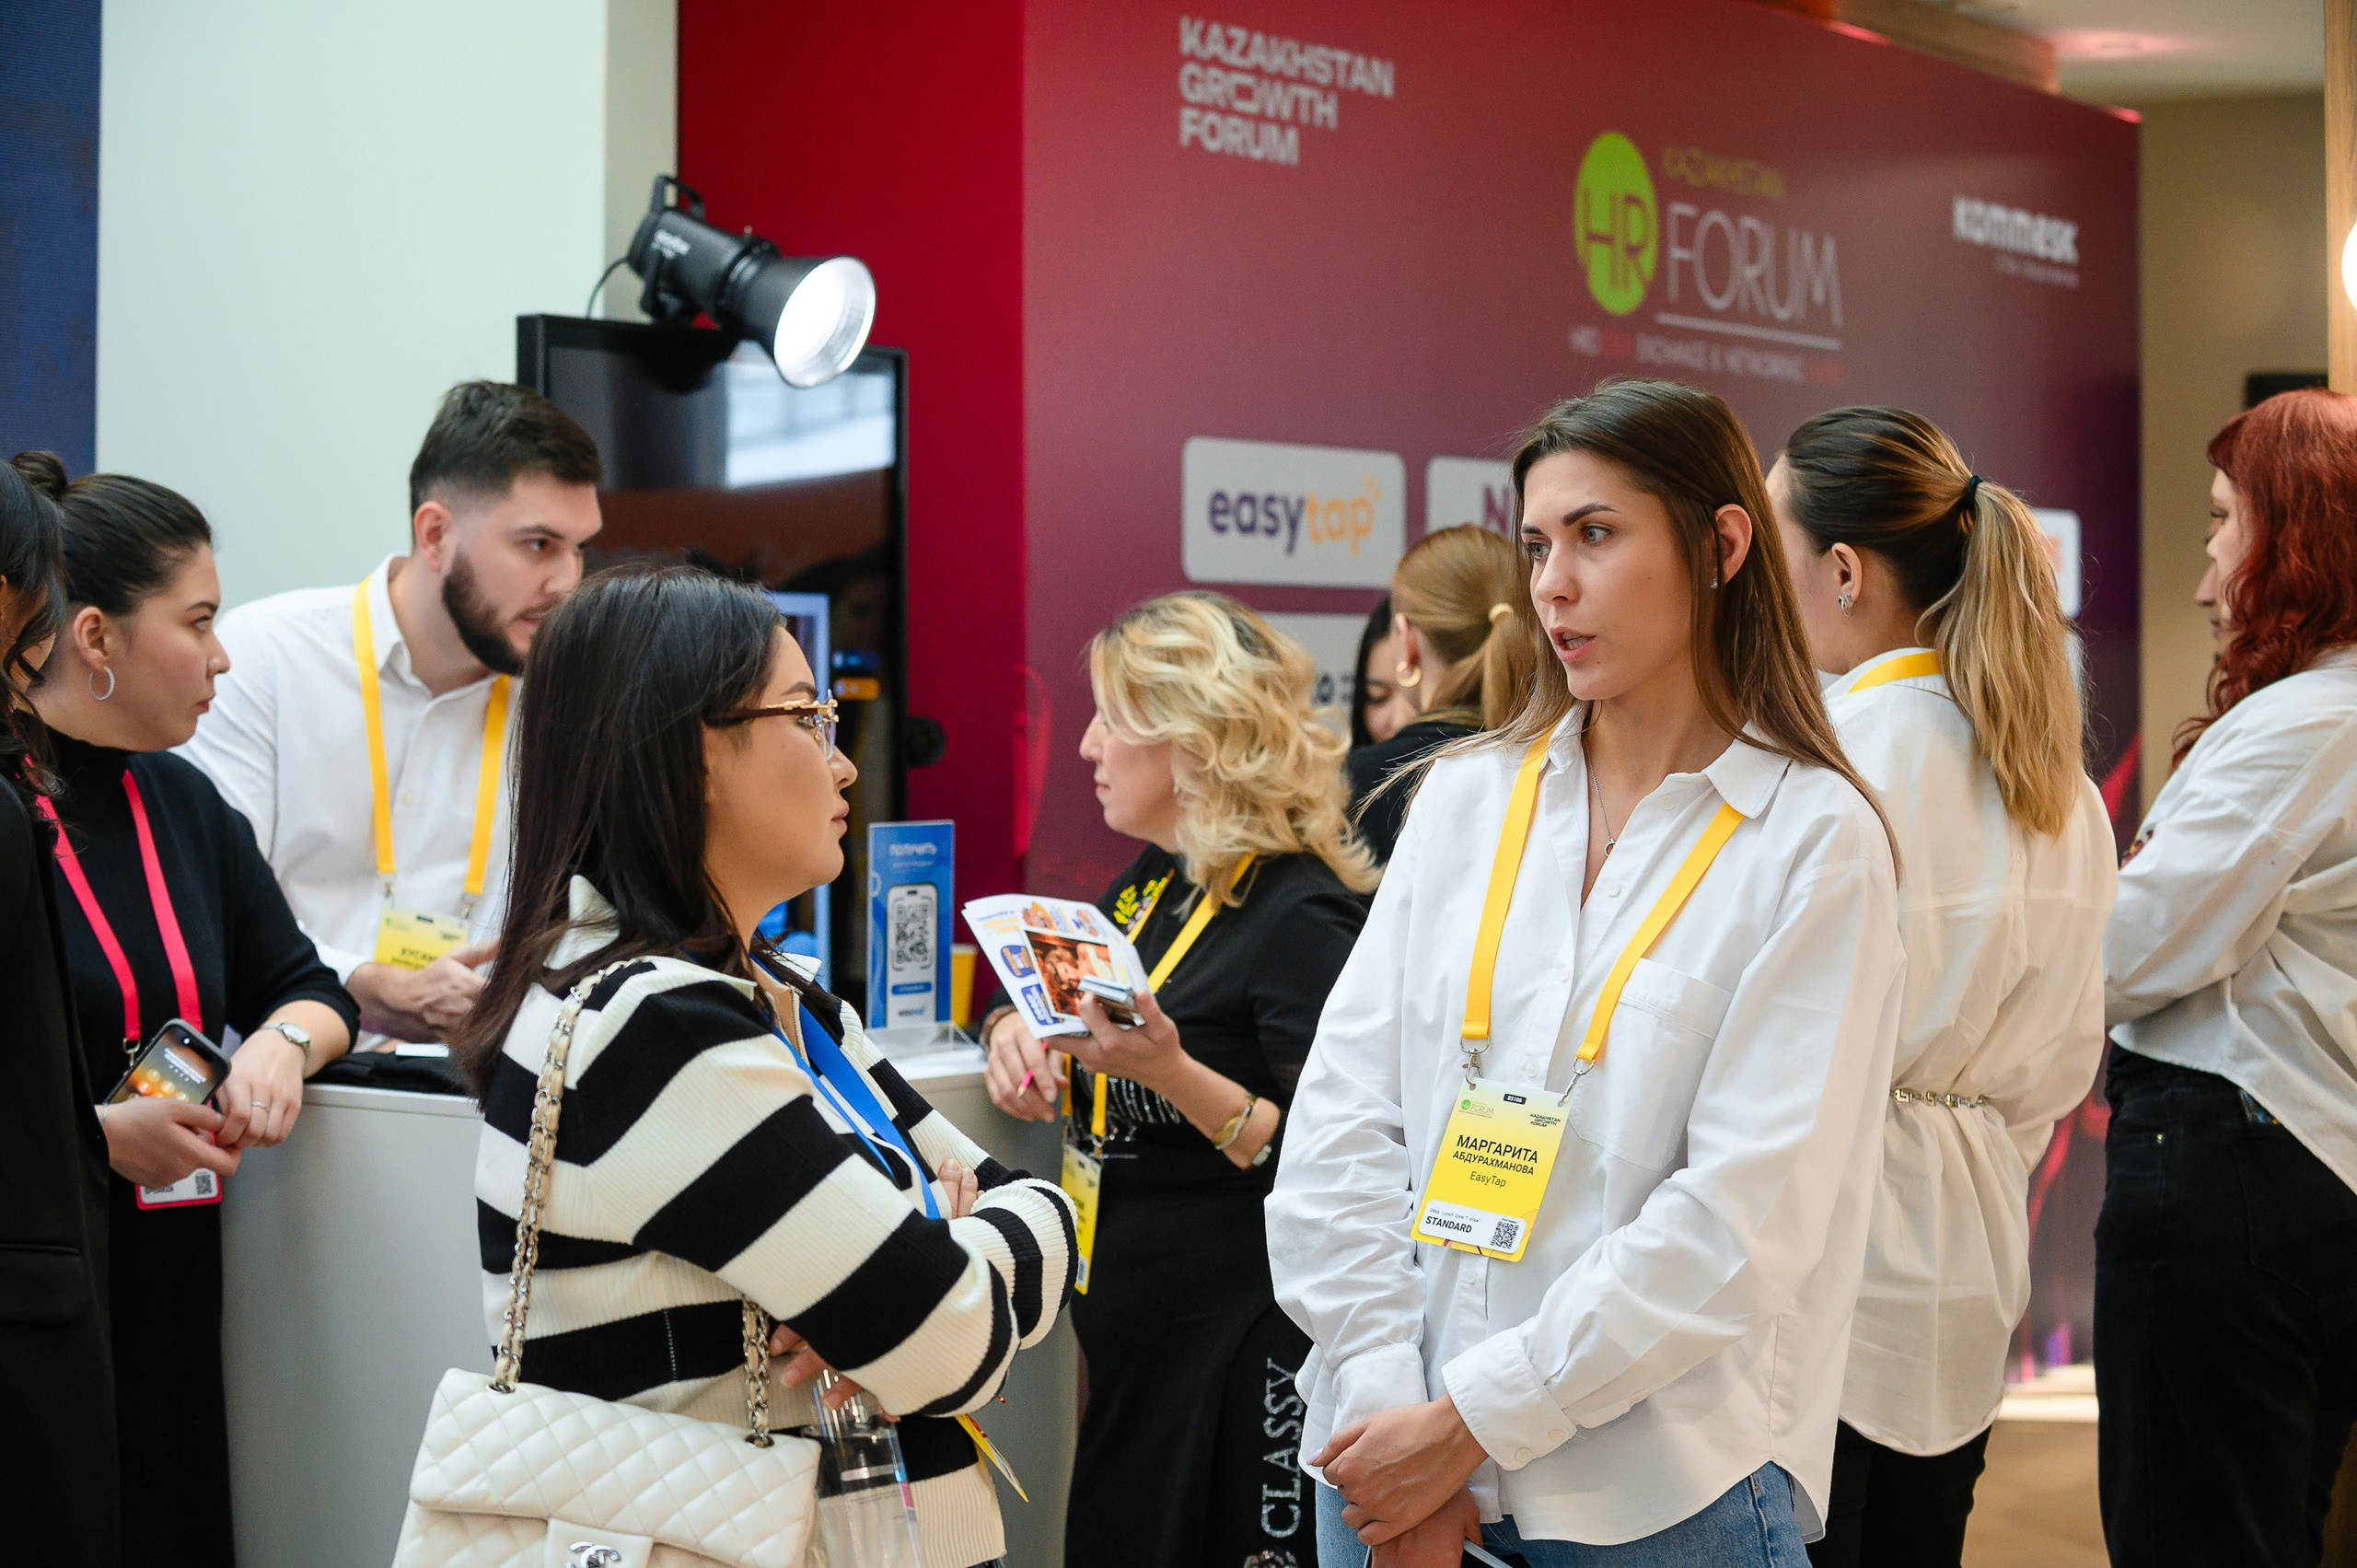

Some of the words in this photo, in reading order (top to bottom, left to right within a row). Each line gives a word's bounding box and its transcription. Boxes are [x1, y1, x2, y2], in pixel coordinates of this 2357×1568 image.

[1179, 16, 1394, 99] KAZAKHSTAN
[1178, 62, 1338, 130] GROWTH
[1179, 107, 1299, 167] FORUM
[1667, 200, 1842, 329] FORUM
[1208, 487, 1376, 556] easytap
[1471, 1104, 1493, 1114] FORUM
[1452, 1150, 1535, 1176] АБДУРАХМАНОВА
[1457, 1134, 1538, 1163] МАРГАРИТА
[1470, 1171, 1506, 1188] EasyTap
[1425, 1215, 1472, 1233] STANDARD
[1260, 1357, 1305, 1539] CLASSY
